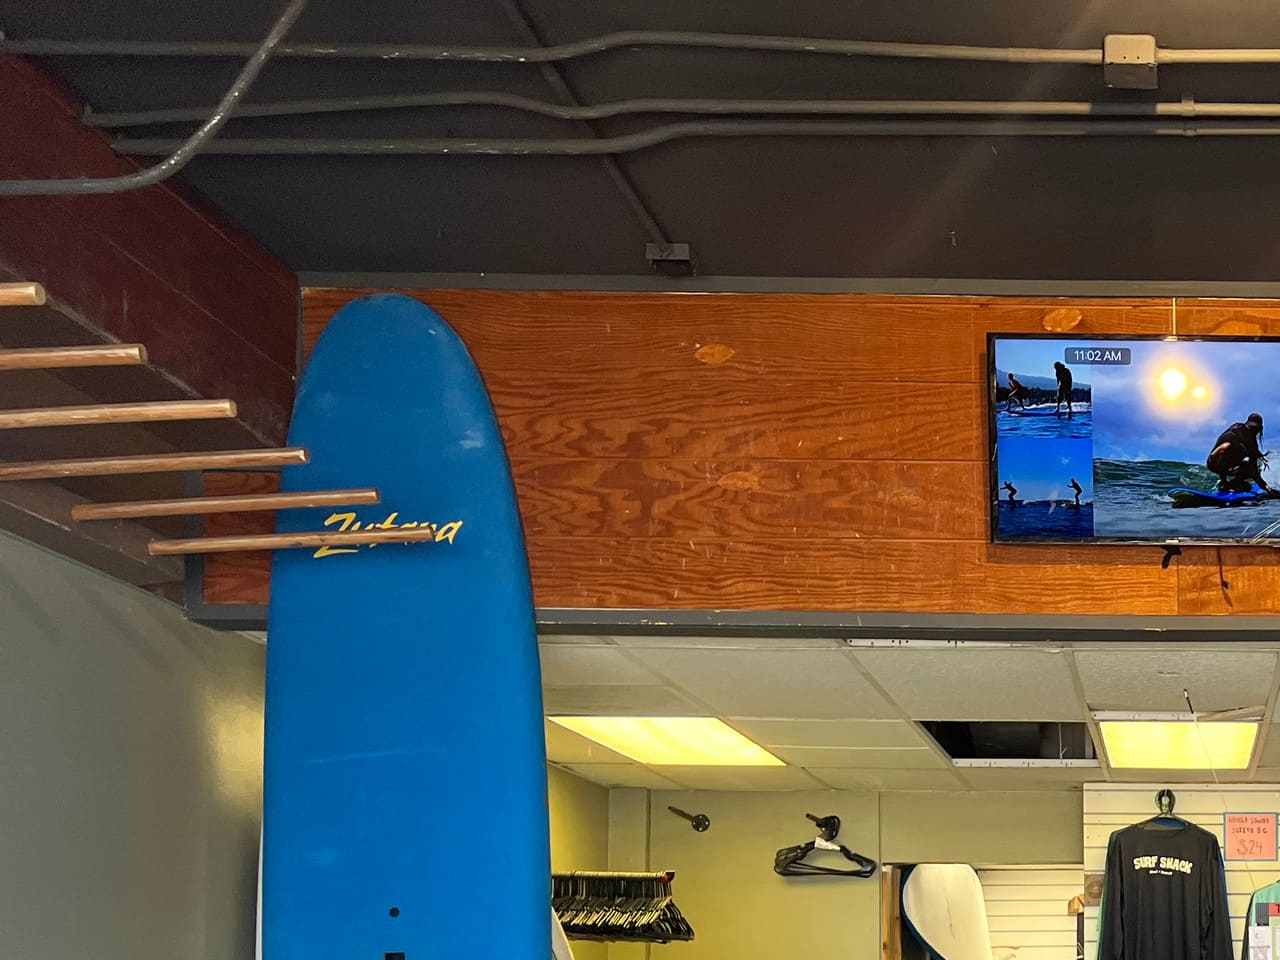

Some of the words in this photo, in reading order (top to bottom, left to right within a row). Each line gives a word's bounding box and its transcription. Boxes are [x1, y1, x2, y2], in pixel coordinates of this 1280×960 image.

[1074, 350, 1101, 361] 11:02
[1103, 350, 1122, 361] AM
[1133, 855, 1159, 870] SURF
[1160, 856, 1194, 875] SHACK
